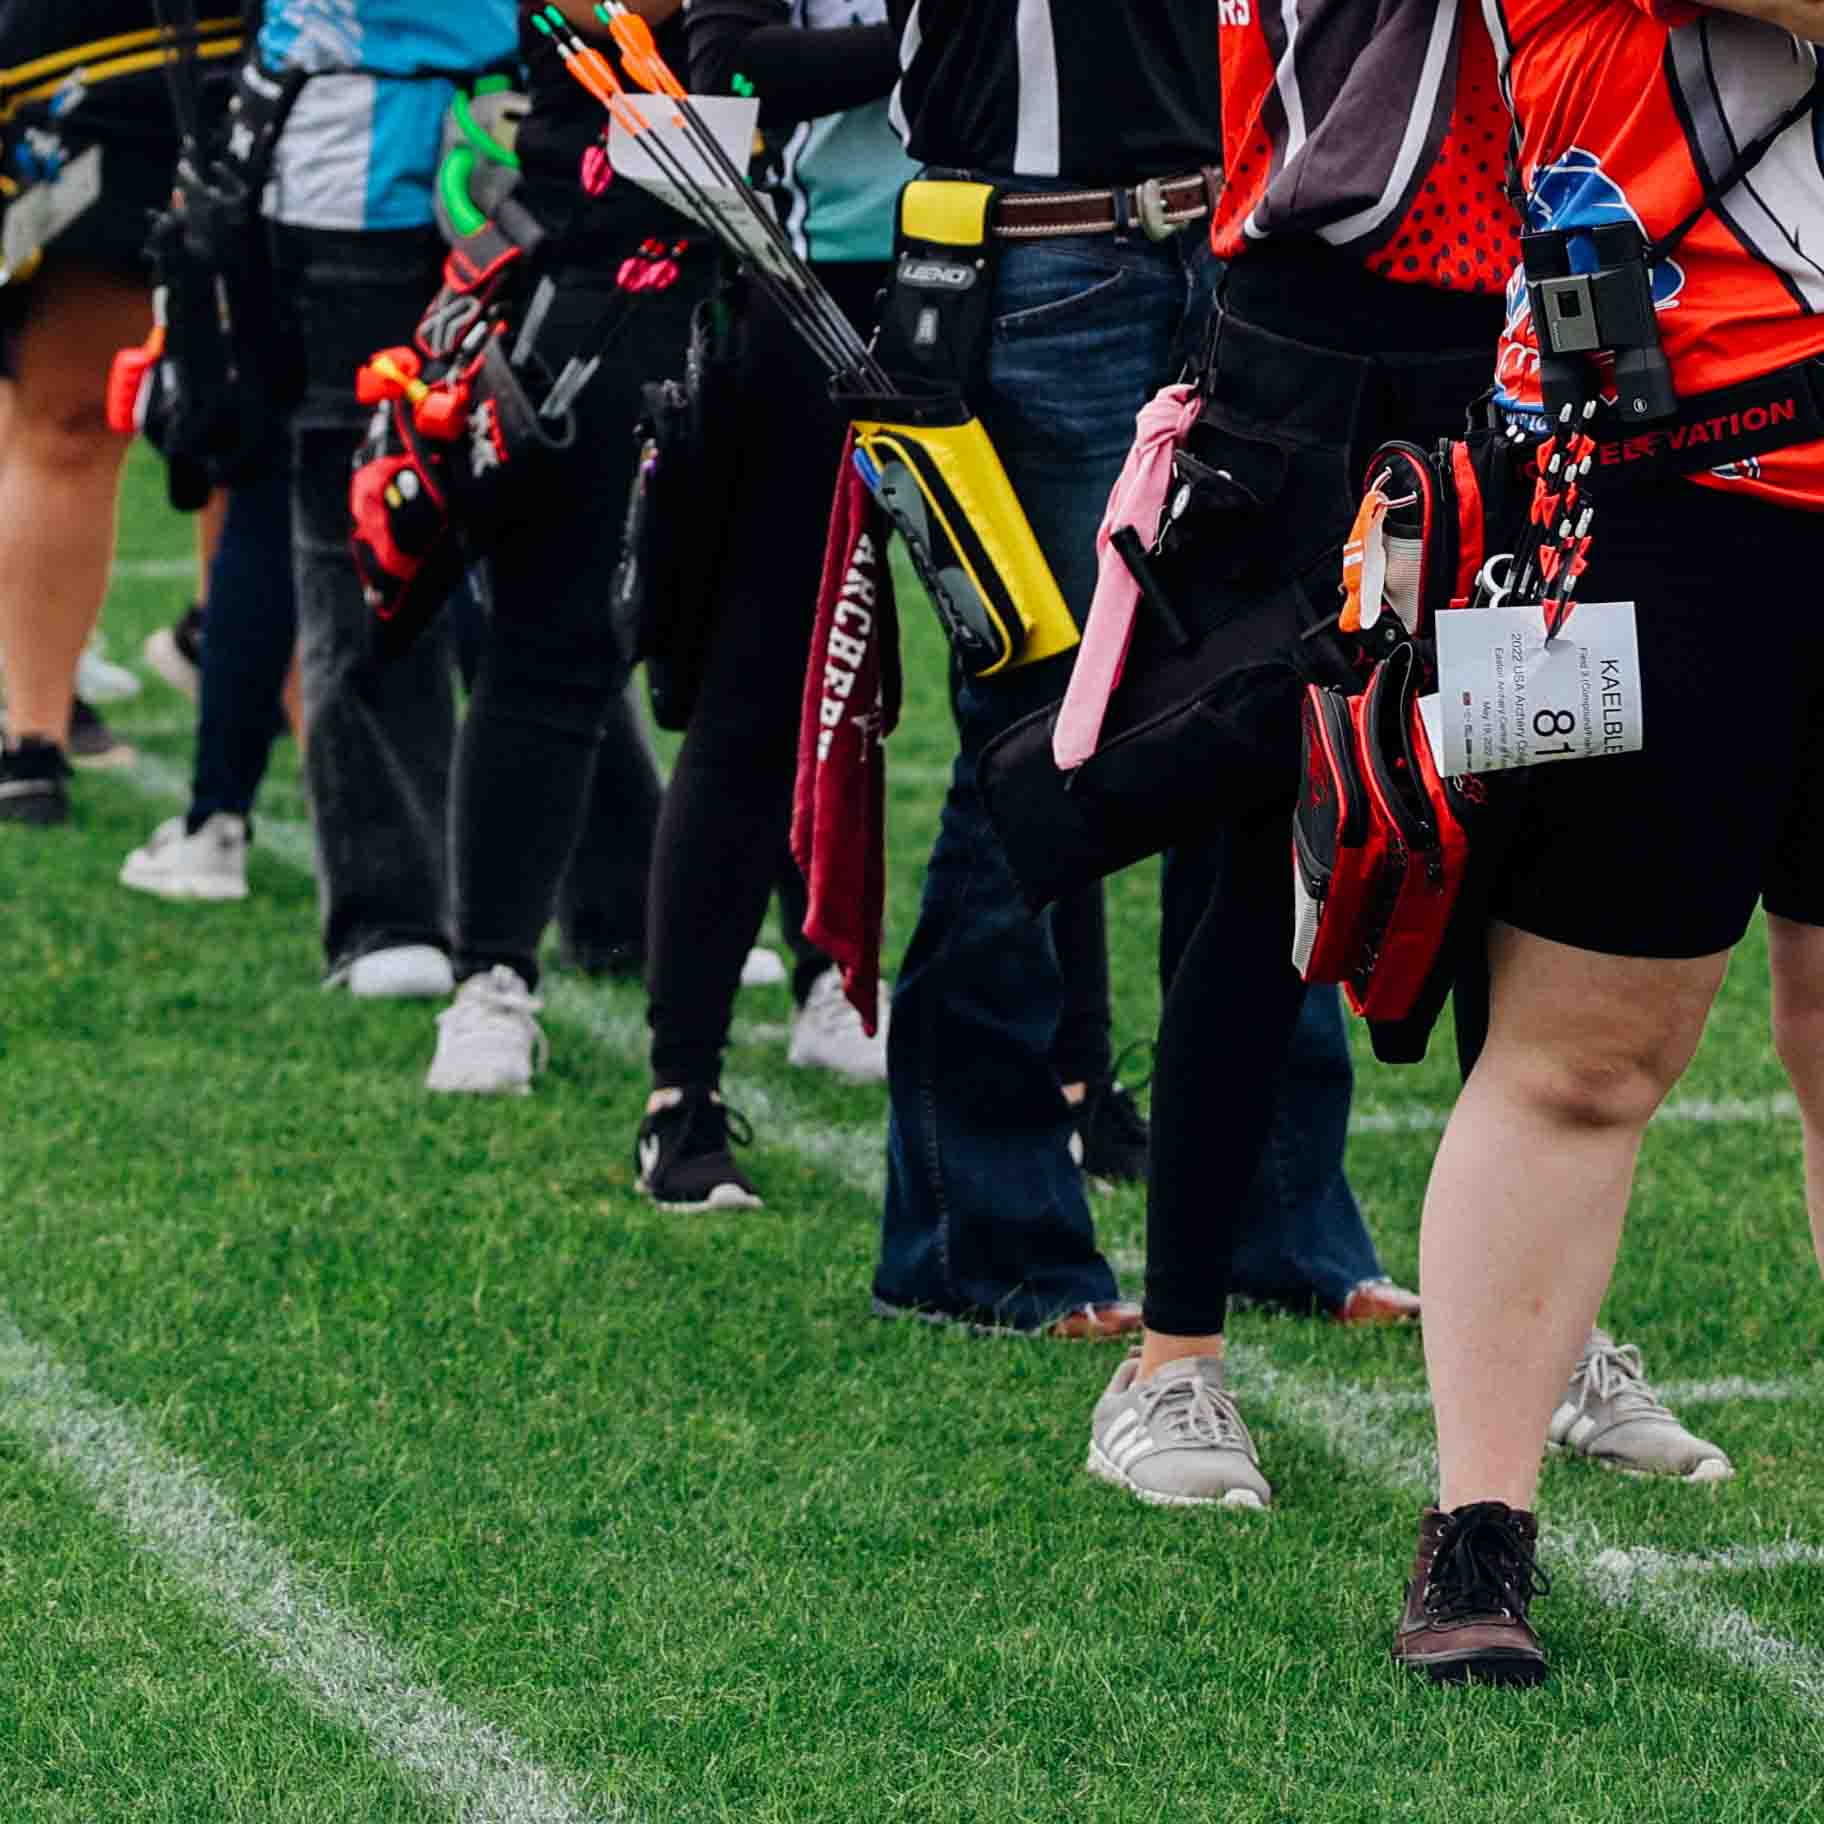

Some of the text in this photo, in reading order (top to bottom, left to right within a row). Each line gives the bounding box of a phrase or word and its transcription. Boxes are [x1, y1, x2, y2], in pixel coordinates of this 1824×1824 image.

[1511, 632, 1522, 662] 2022
[1513, 665, 1524, 692] USA
[1514, 695, 1526, 738] Archery
[1533, 709, 1576, 755] 81
